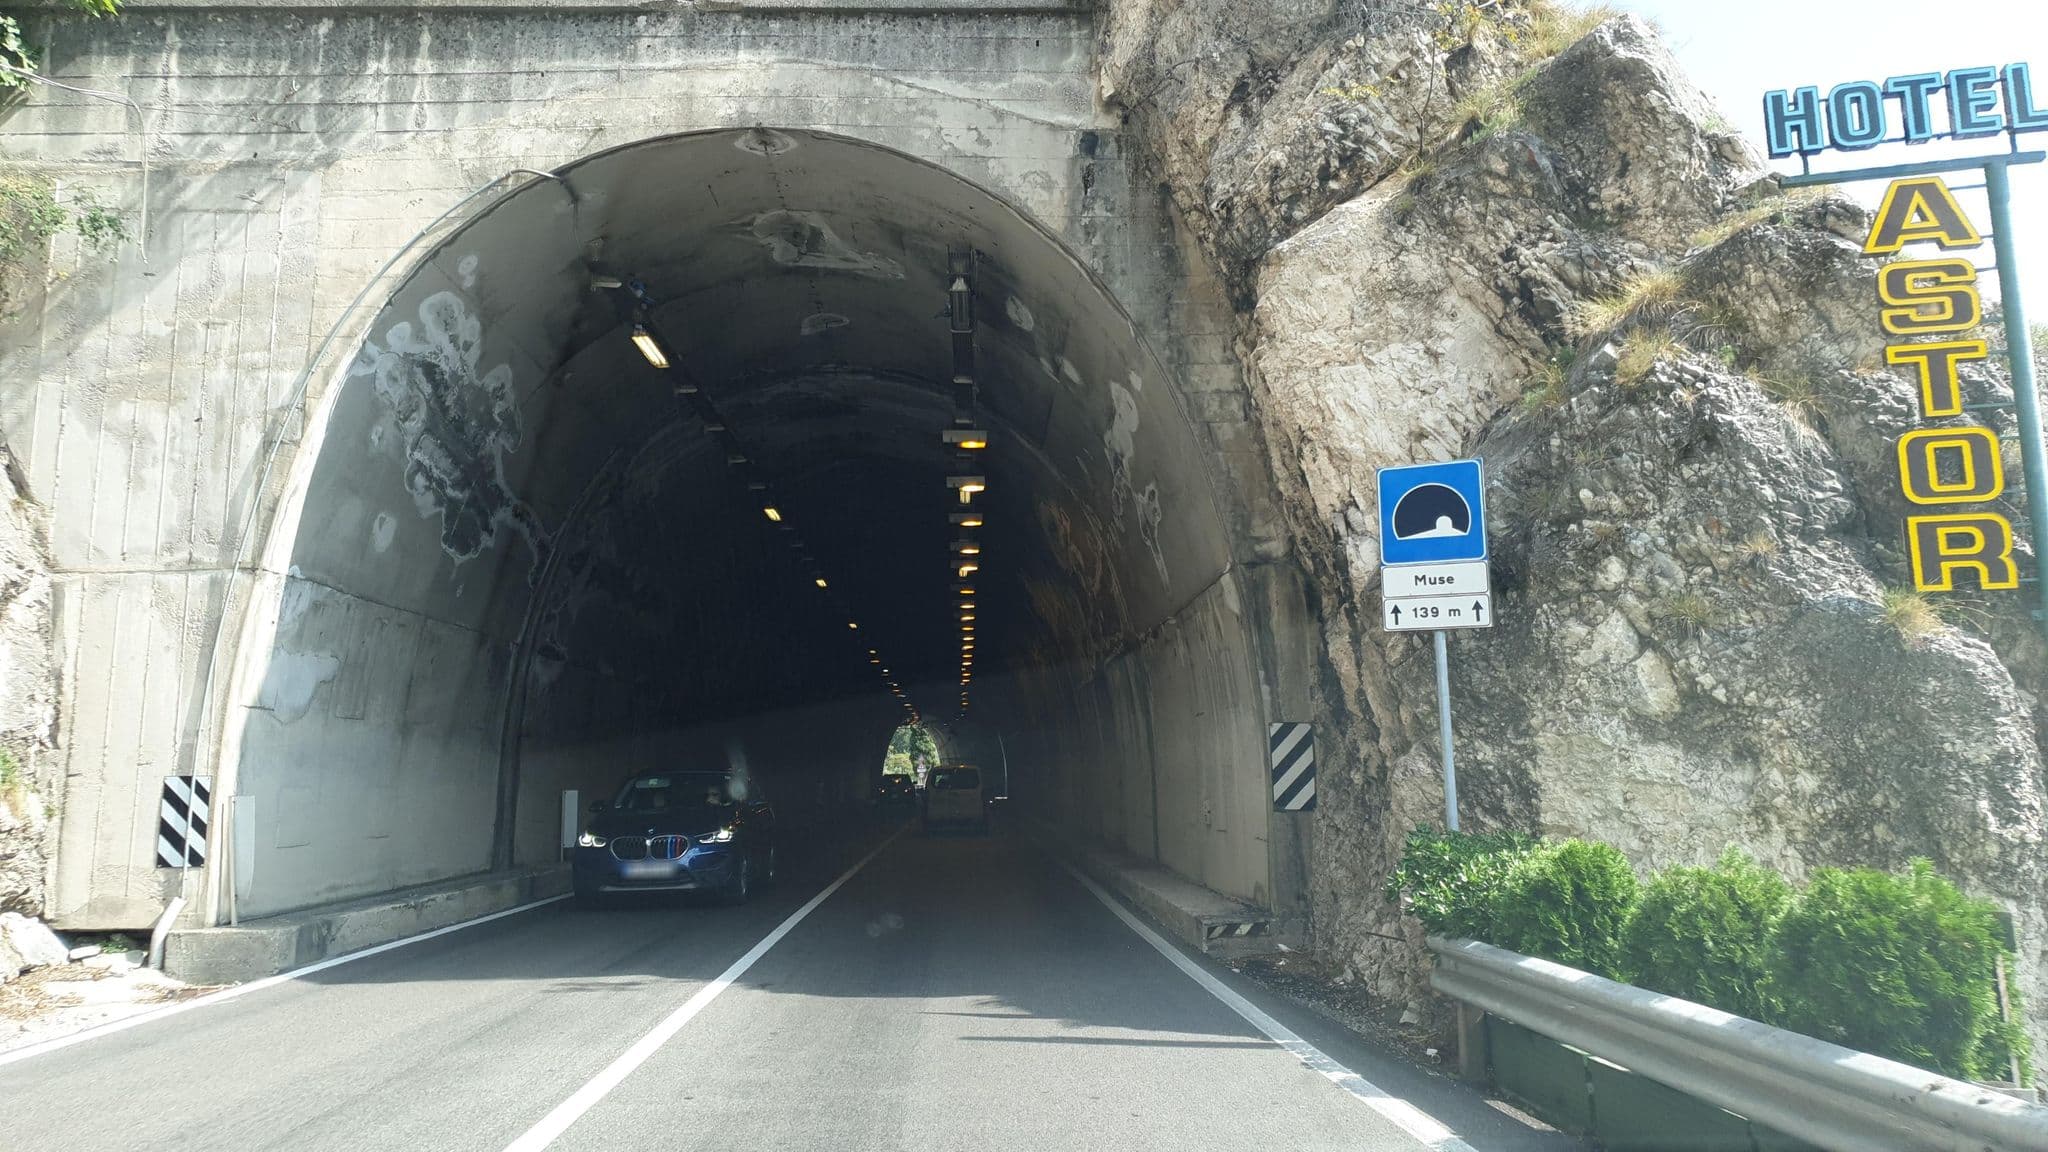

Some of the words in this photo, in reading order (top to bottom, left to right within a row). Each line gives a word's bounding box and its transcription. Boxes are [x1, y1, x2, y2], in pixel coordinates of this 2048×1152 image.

[1763, 62, 2048, 158] HOTEL
[1863, 176, 2019, 592] ASTOR
[1414, 574, 1455, 586] Muse
[1412, 606, 1439, 618] 139
[1448, 608, 1461, 617] m
